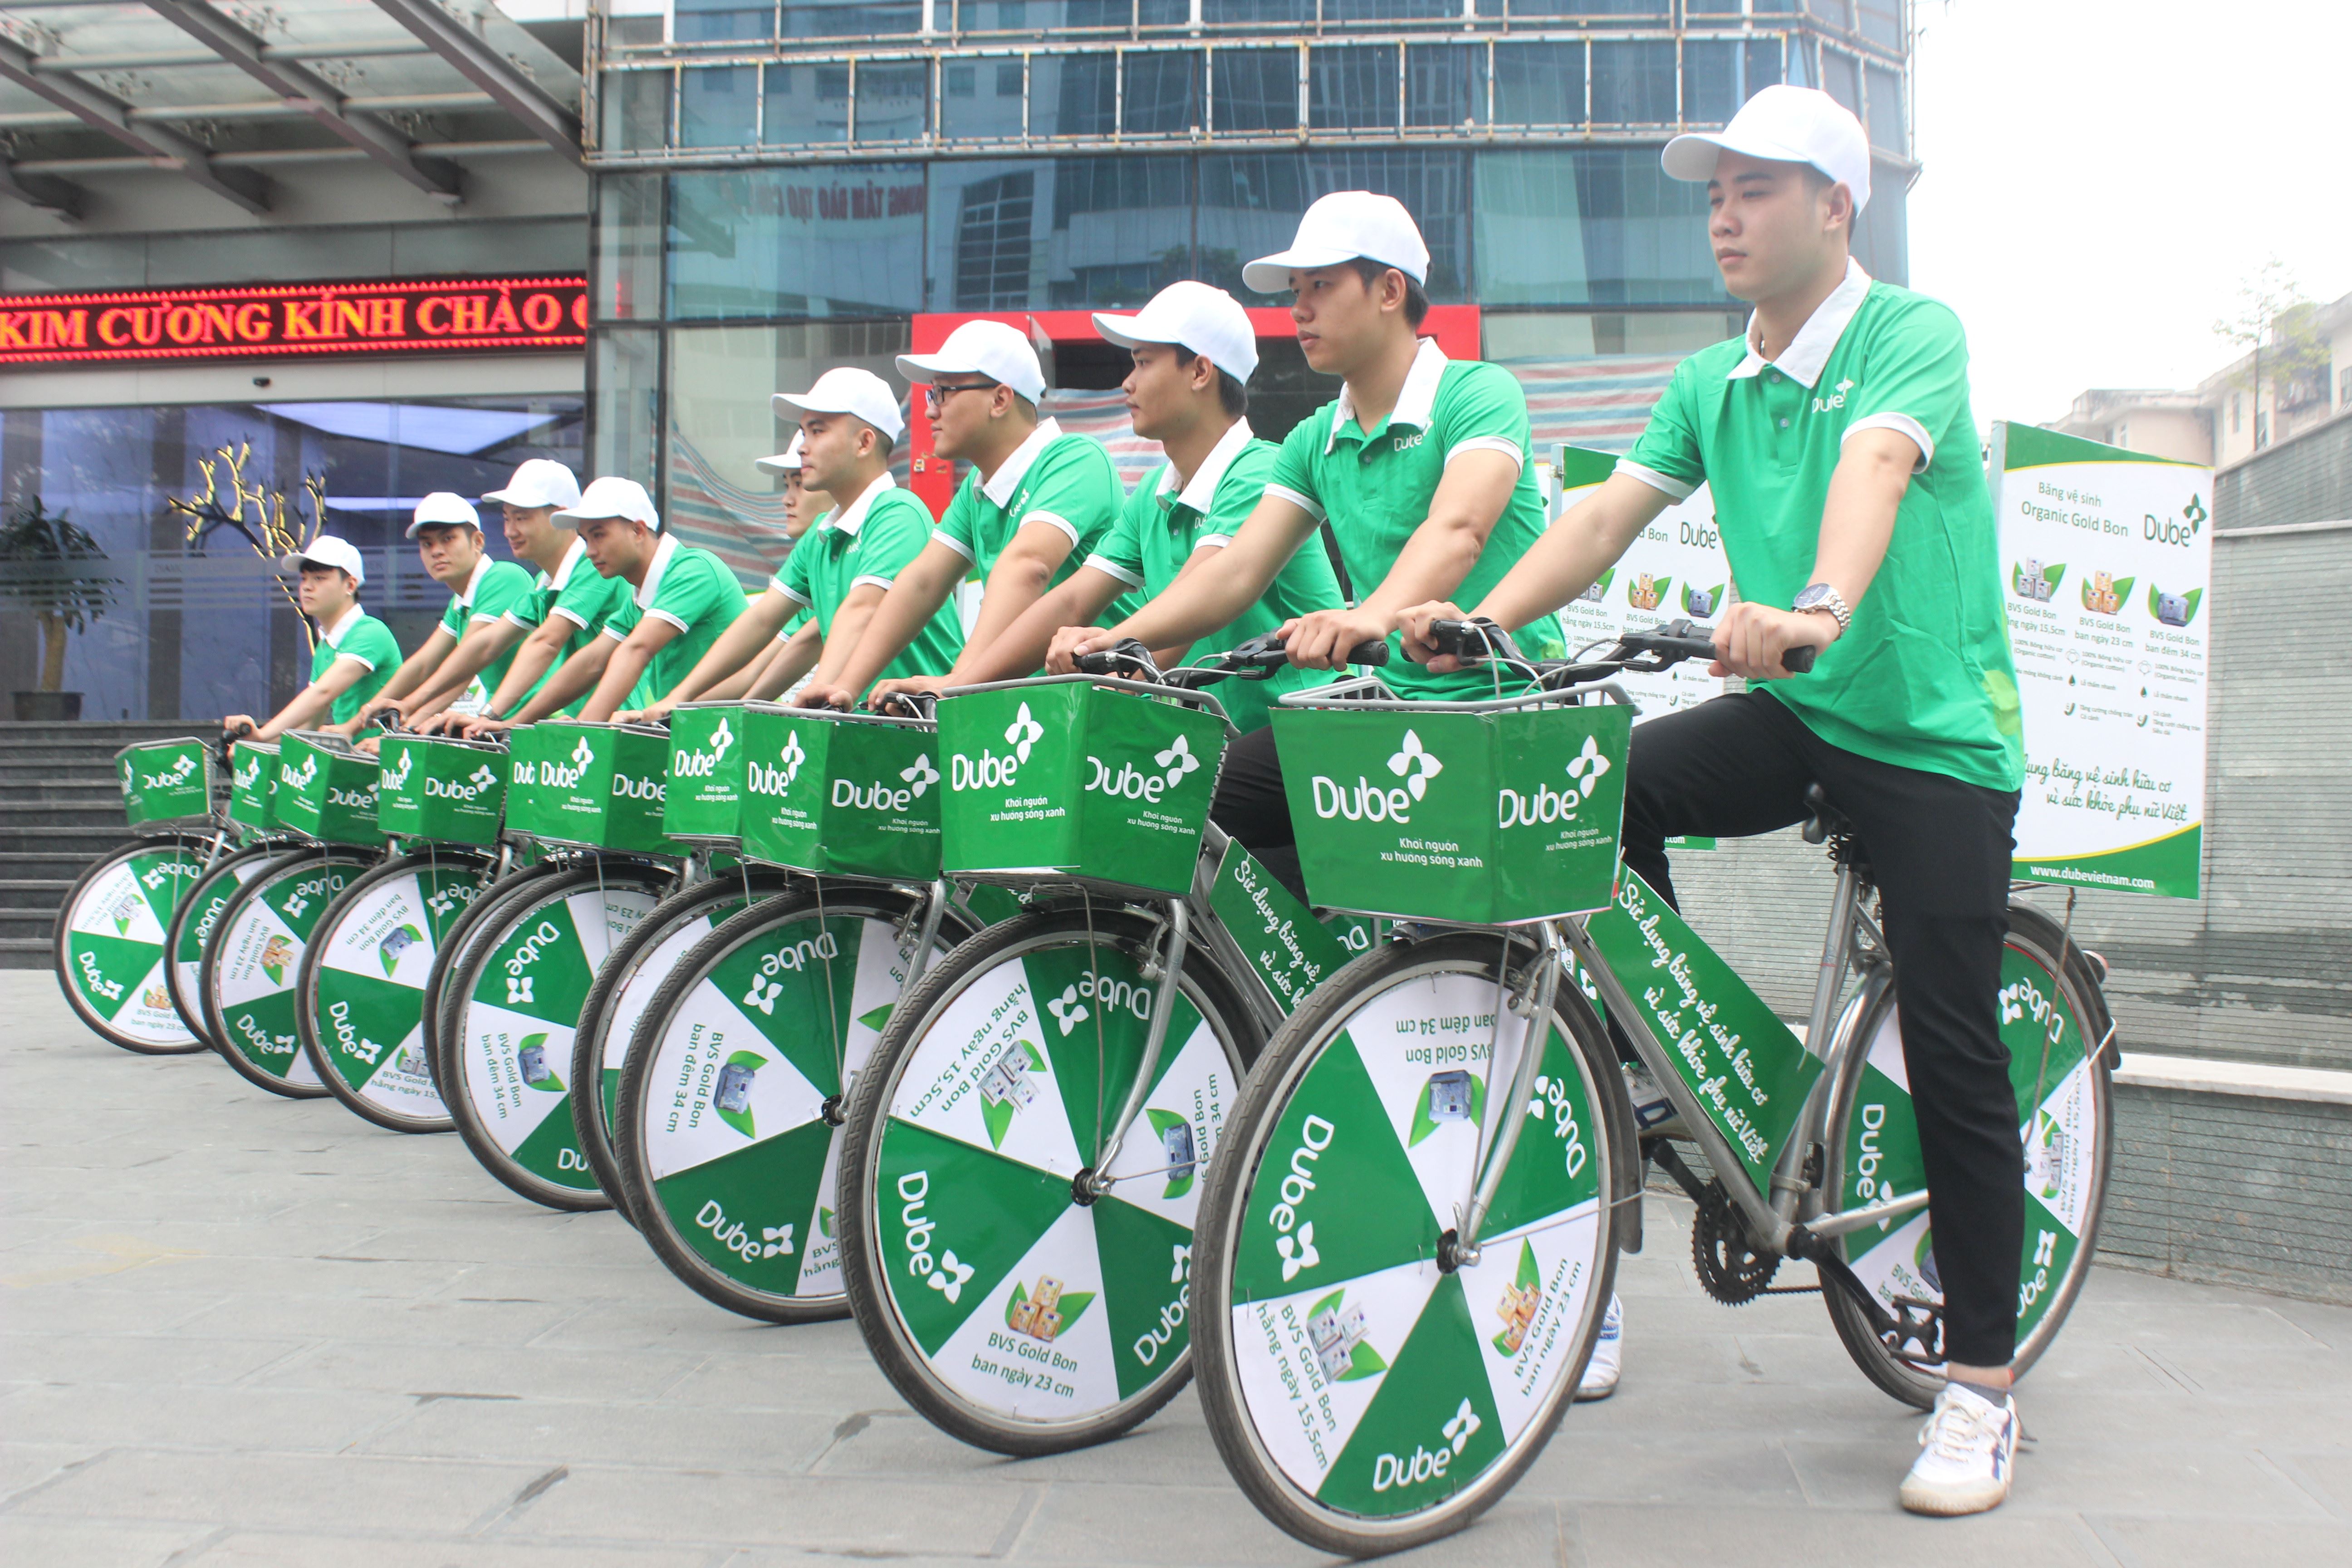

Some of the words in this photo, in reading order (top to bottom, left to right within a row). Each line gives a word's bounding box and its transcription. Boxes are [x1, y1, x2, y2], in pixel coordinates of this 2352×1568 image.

[0, 309, 89, 349] KIM
[282, 292, 407, 339] KÍNH
[416, 286, 562, 335] CHÀO
[2039, 481, 2064, 501] Băng
[2067, 489, 2078, 504] vệ
[2081, 493, 2101, 508] sinh
[2021, 500, 2068, 524] Organic
[2072, 512, 2099, 531] Gold
[2104, 520, 2128, 537] Bon
[2145, 514, 2191, 547] Dube
[1648, 528, 1668, 542] Bon
[1680, 521, 1717, 549] Dube
[1567, 604, 1578, 613] BVS
[1580, 607, 1594, 615] Gold
[1596, 609, 1607, 617] Bon
[1578, 619, 1592, 629] ngày
[1594, 621, 1615, 631] 15,5cm
[2008, 603, 2021, 612] BVS
[2024, 606, 2040, 616] Gold
[2043, 609, 2056, 619] Bon
[2080, 617, 2094, 627] BVS
[2096, 620, 2113, 631] Gold
[2116, 623, 2131, 633] Bon
[2020, 621, 2038, 632] ngày
[2040, 623, 2065, 635] 15,5cm
[2075, 630, 2089, 640] ban
[2091, 634, 2108, 645] ngày
[2111, 637, 2120, 645] 23
[2150, 630, 2164, 640] BVS
[2166, 633, 2183, 643] Gold
[2185, 636, 2200, 646] Bon
[2145, 643, 2159, 653] ban
[2161, 646, 2178, 656] đêm
[2180, 649, 2189, 658] 34
[281, 764, 305, 791] Dube
[541, 760, 579, 789] Dube
[675, 748, 715, 777] Dube
[952, 749, 1017, 791] Dube
[2025, 754, 2049, 784] ụng
[2053, 758, 2082, 789] băng
[2086, 766, 2101, 788] vệ
[2103, 768, 2129, 787] sinh
[2132, 769, 2156, 791] hữu
[2159, 779, 2171, 792] cơ
[382, 769, 403, 791] Dube
[425, 777, 477, 801] Dube
[612, 773, 666, 802] Dube
[749, 761, 789, 797] Dube
[1085, 755, 1164, 803] Dube
[832, 779, 911, 812] Dube
[1312, 775, 1410, 824] Dube
[1499, 783, 1579, 829] Dube
[2047, 788, 2058, 804] vì
[2062, 789, 2082, 807] sức
[2117, 795, 2141, 820] phụ
[2144, 802, 2159, 818] nữ
[2162, 802, 2187, 826] Việt
[157, 862, 201, 879] Dube
[1380, 851, 1393, 861] xu
[1456, 856, 1483, 868] xanh
[296, 875, 344, 896] Dube
[2030, 866, 2155, 889] www.dubevietnam.com
[1234, 861, 1256, 894] Sử
[1252, 887, 1279, 934] dụng
[1279, 920, 1304, 969] băng
[1303, 960, 1321, 985] vệ
[505, 921, 561, 976] Dube
[761, 931, 838, 976] Dube
[79, 951, 104, 993] Dube
[1259, 950, 1276, 971] vì
[1272, 970, 1292, 996] sức
[991, 983, 1027, 1022] hằng
[1081, 970, 1151, 1020] Dube
[1619, 883, 1646, 921] Sử
[1639, 914, 1671, 968] dụng
[1669, 952, 1698, 1008] băng
[1695, 1000, 1717, 1027] vệ
[1710, 1024, 1740, 1059] sinh
[1731, 1048, 1754, 1090] hữu
[1751, 1087, 1768, 1106] cơ
[1002, 1009, 1029, 1042] BVS
[1396, 1019, 1416, 1033] cm
[1420, 1018, 1436, 1035] 34
[1441, 1015, 1470, 1034] đêm
[2019, 977, 2065, 1045] Dube
[236, 1014, 273, 1054] Dube
[329, 1001, 358, 1054] Dube
[688, 1024, 706, 1050] ban
[961, 1022, 992, 1060] ngày
[481, 1034, 492, 1056] ban
[498, 1033, 511, 1055] BVS
[706, 1032, 724, 1060] BVS
[1406, 1048, 1431, 1064] Bon
[1436, 1045, 1467, 1064] Gold
[487, 1058, 500, 1083] đêm
[505, 1057, 519, 1083] Gold
[679, 1054, 697, 1086] đêm
[970, 1042, 1002, 1081] Gold
[1644, 986, 1664, 1010] vì
[1657, 1010, 1681, 1039] sức
[1699, 1075, 1727, 1112] phụ
[1724, 1107, 1745, 1132] nữ
[1738, 1120, 1769, 1165] Việt
[494, 1085, 505, 1099] 34
[510, 1085, 522, 1107] Bon
[697, 1063, 715, 1097] Gold
[910, 1061, 961, 1117] 15,5cm
[941, 1080, 970, 1112] Bon
[498, 1102, 507, 1119] cm
[673, 1090, 687, 1107] 34
[688, 1100, 706, 1128] Bon
[666, 1111, 679, 1132] cm
[1548, 1078, 1585, 1179] Dube
[1857, 1104, 1884, 1198] Dube
[1269, 1114, 1334, 1233] Dube
[695, 1200, 762, 1263] Dube
[897, 1171, 934, 1277] Dube
[1134, 1284, 1189, 1366] Dube
[988, 1332, 1015, 1352] BVS
[1018, 1342, 1050, 1363] Gold
[1052, 1352, 1078, 1372] Bon
[1281, 1303, 1304, 1344] BVS
[1299, 1347, 1324, 1392] Gold
[1318, 1393, 1336, 1432] Bon
[971, 1352, 998, 1375] ban
[1000, 1367, 1033, 1387] ngày
[1035, 1373, 1053, 1391] 23
[1054, 1383, 1074, 1398] cm
[1257, 1303, 1282, 1355] hằng
[1278, 1356, 1301, 1400] ngày
[1298, 1403, 1328, 1470] 15,5cm
[1373, 1445, 1451, 1491] Dube
